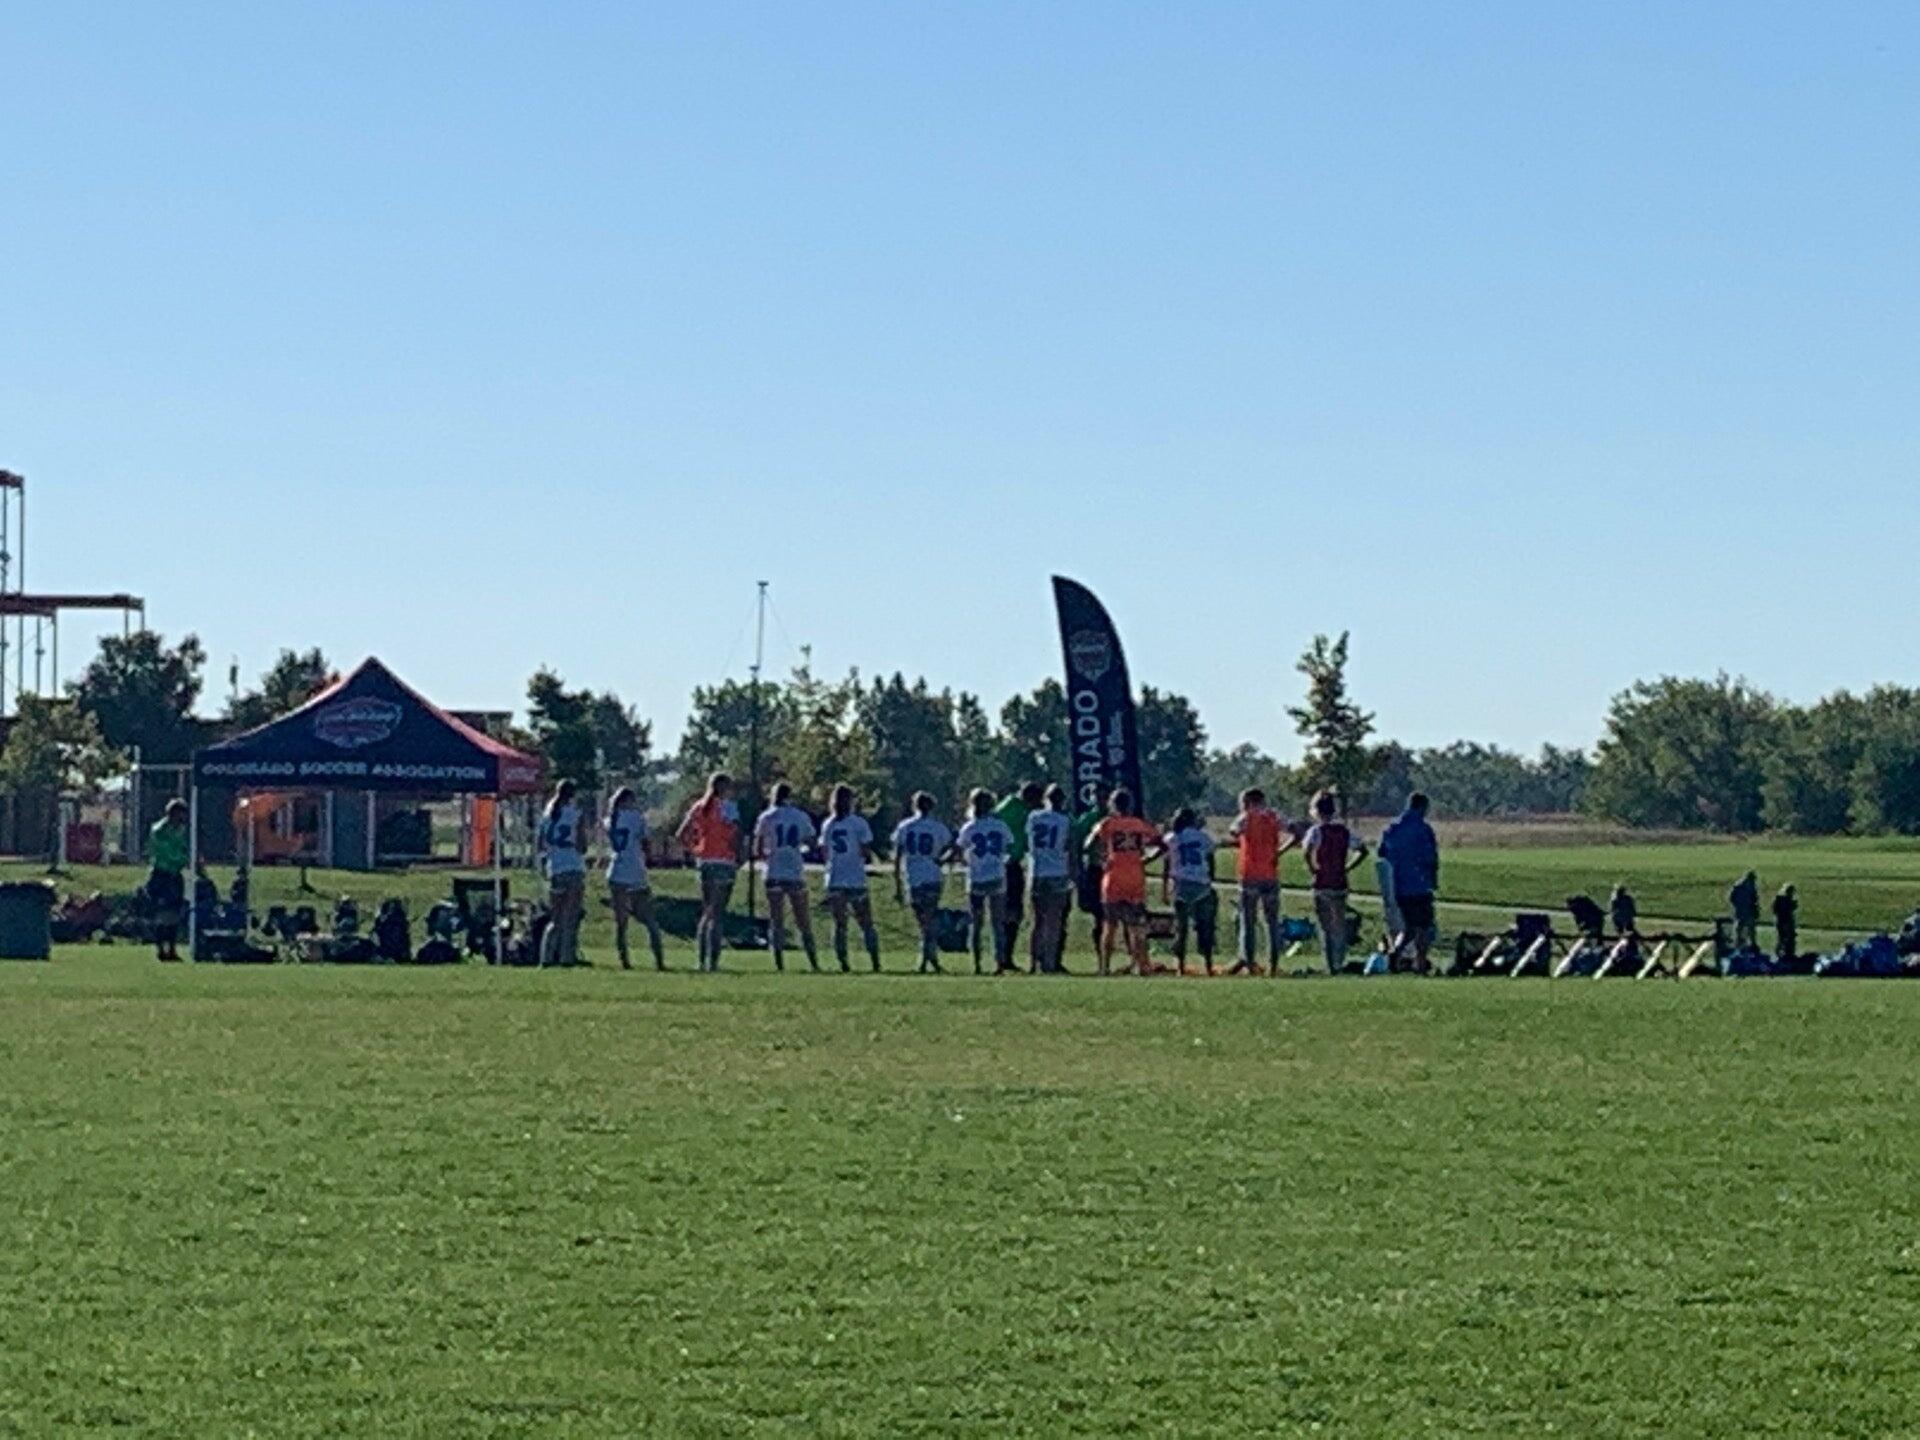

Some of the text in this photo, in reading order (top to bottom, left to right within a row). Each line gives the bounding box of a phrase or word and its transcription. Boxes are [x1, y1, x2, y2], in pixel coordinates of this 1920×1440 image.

[299, 761, 367, 775] SOCCER
[372, 763, 486, 779] ASSOCIATION
[832, 828, 848, 853] 5
[1032, 822, 1058, 849] 21
